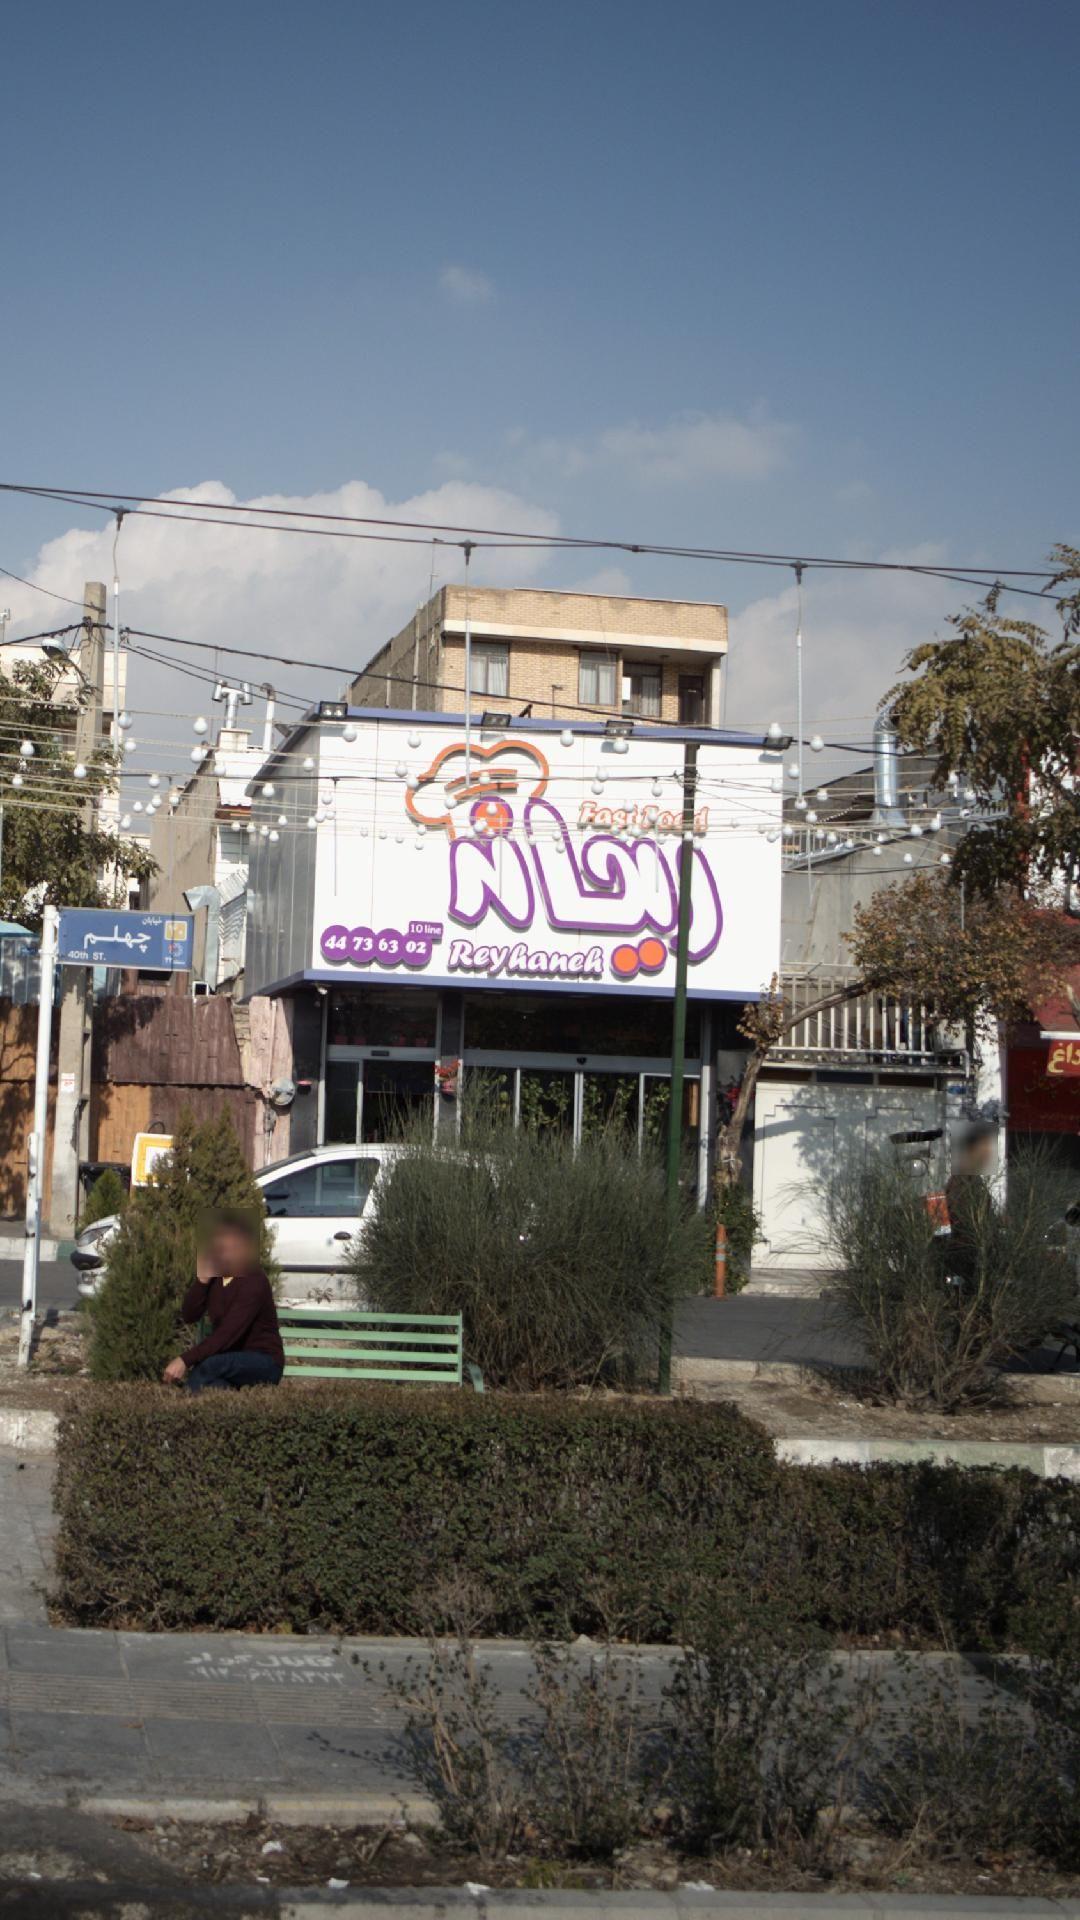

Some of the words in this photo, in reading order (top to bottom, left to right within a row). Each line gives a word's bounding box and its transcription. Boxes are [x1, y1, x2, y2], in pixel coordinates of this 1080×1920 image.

[580, 801, 638, 828] Fast
[640, 804, 709, 832] Food
[448, 796, 723, 977] ریحانه
[142, 916, 163, 926] خیابان
[410, 923, 423, 935] 10
[425, 924, 442, 936] line
[84, 924, 151, 953] چهلم
[325, 935, 347, 950] 44
[352, 936, 373, 951] 73
[378, 938, 399, 954] 63
[405, 940, 427, 954] 02
[68, 950, 89, 960] 40th
[92, 952, 107, 961] ST.
[449, 939, 604, 978] Reyhaneh
